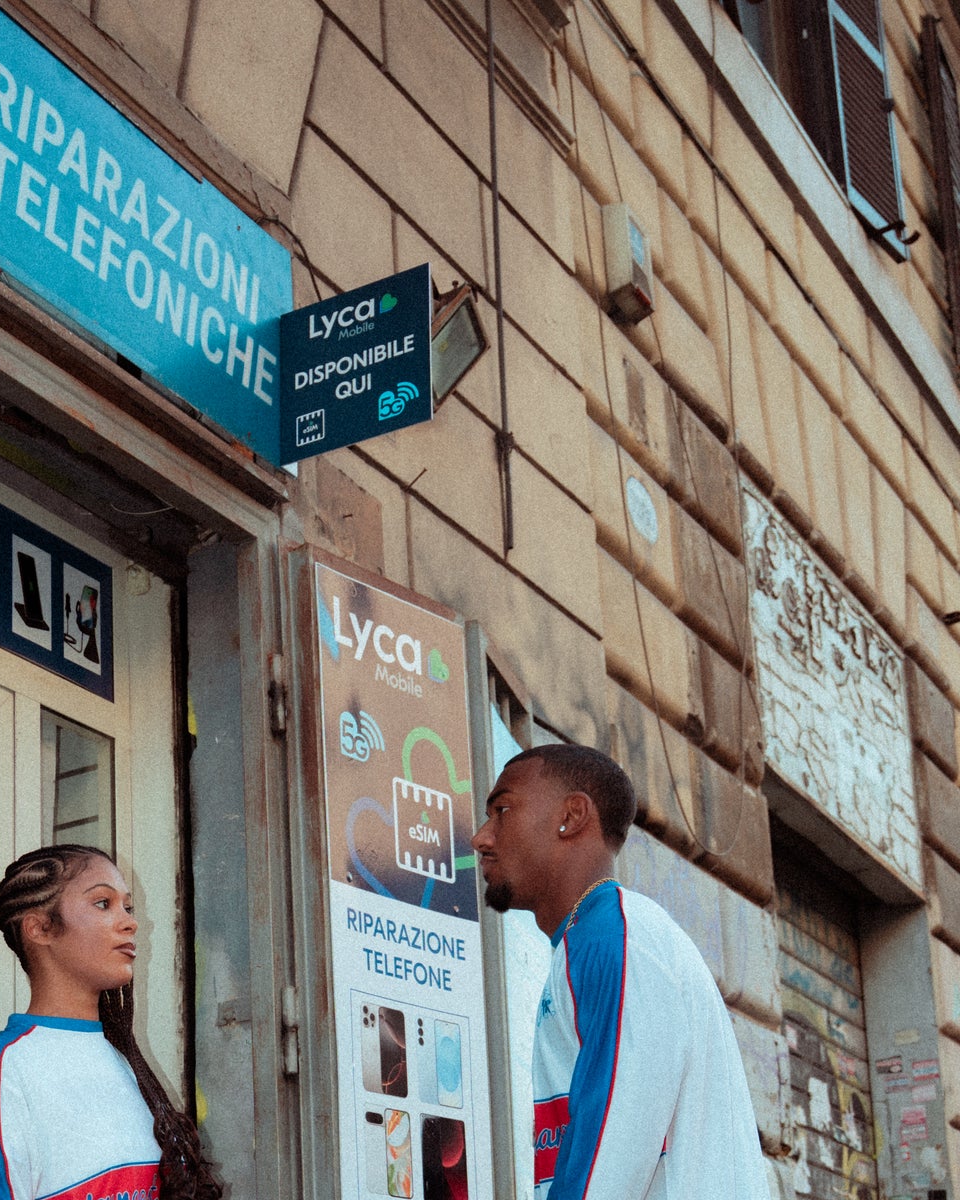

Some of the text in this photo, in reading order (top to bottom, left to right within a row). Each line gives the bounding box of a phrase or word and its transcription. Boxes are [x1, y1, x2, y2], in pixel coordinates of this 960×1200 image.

[308, 298, 375, 339] Lyca
[338, 321, 375, 341] Mobile
[294, 334, 415, 390] DISPONIBILE
[335, 373, 372, 400] QUI
[379, 394, 406, 419] 5G
[302, 424, 319, 434] eSIM
[332, 595, 422, 676] Lyca
[374, 664, 423, 698] Mobile
[340, 718, 371, 761] 5G
[408, 824, 441, 847] eSIM
[346, 907, 466, 961] RIPARAZIONE
[363, 948, 452, 993] TELEFONE
